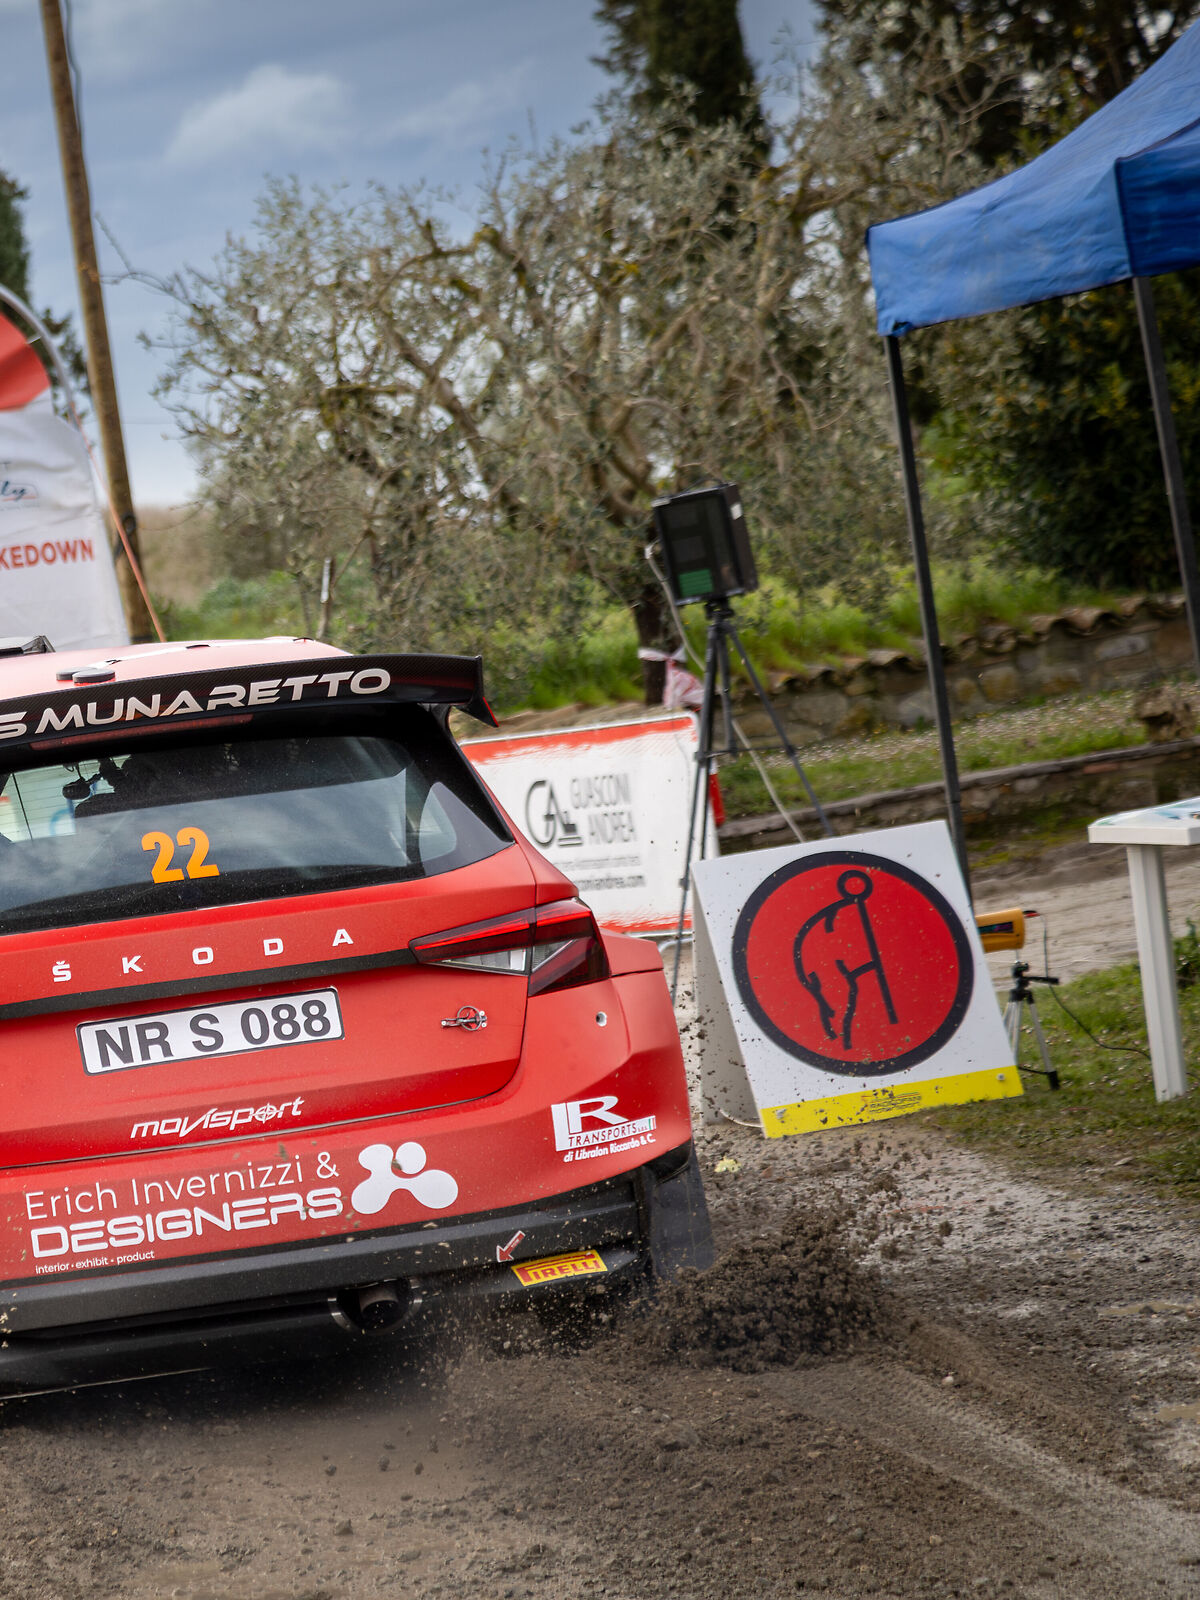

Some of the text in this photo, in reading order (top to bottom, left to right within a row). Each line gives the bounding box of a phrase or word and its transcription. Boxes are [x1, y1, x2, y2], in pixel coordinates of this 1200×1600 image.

[35, 668, 392, 735] MUNARETTO
[570, 772, 632, 809] GUASCONI
[141, 826, 220, 885] 22
[52, 929, 354, 982] ŠKODA
[98, 999, 332, 1069] NR S 088
[563, 1150, 574, 1163] di
[609, 1139, 640, 1154] Riccardo
[639, 1136, 647, 1146] &
[568, 1122, 638, 1148] TRANSPORTS
[25, 1151, 340, 1221] Erich Invernizzi &
[30, 1187, 344, 1259] DESIGNERS
[35, 1250, 155, 1275] interior exhibit product
[516, 1253, 601, 1283] PIRELLI
